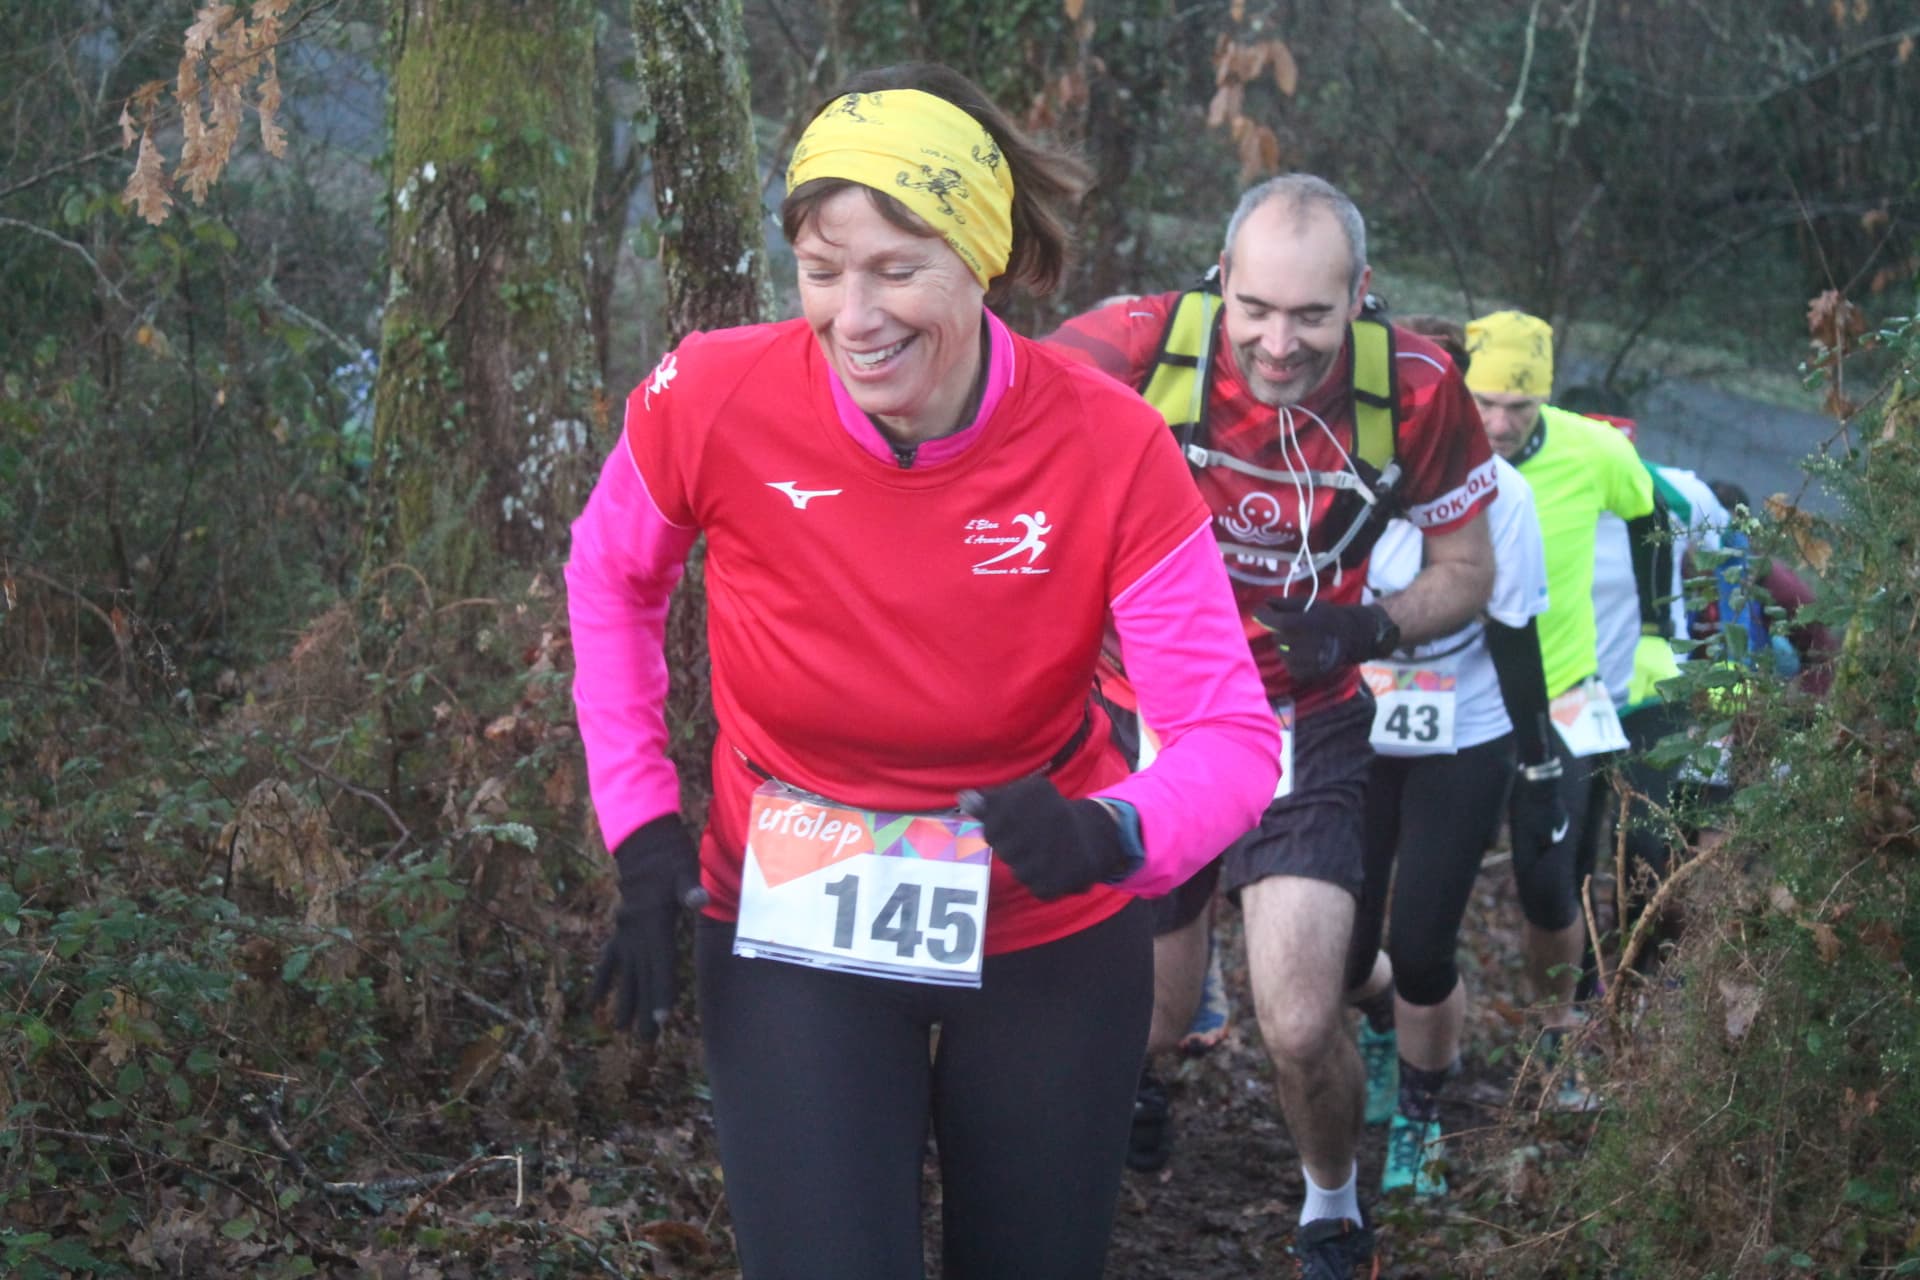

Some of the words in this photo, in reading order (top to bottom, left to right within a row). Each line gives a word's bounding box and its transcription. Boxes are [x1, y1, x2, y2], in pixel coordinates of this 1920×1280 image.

[1423, 464, 1497, 523] TOKOL
[1385, 703, 1440, 742] 43
[758, 806, 863, 857] ufolep
[824, 873, 979, 965] 145
